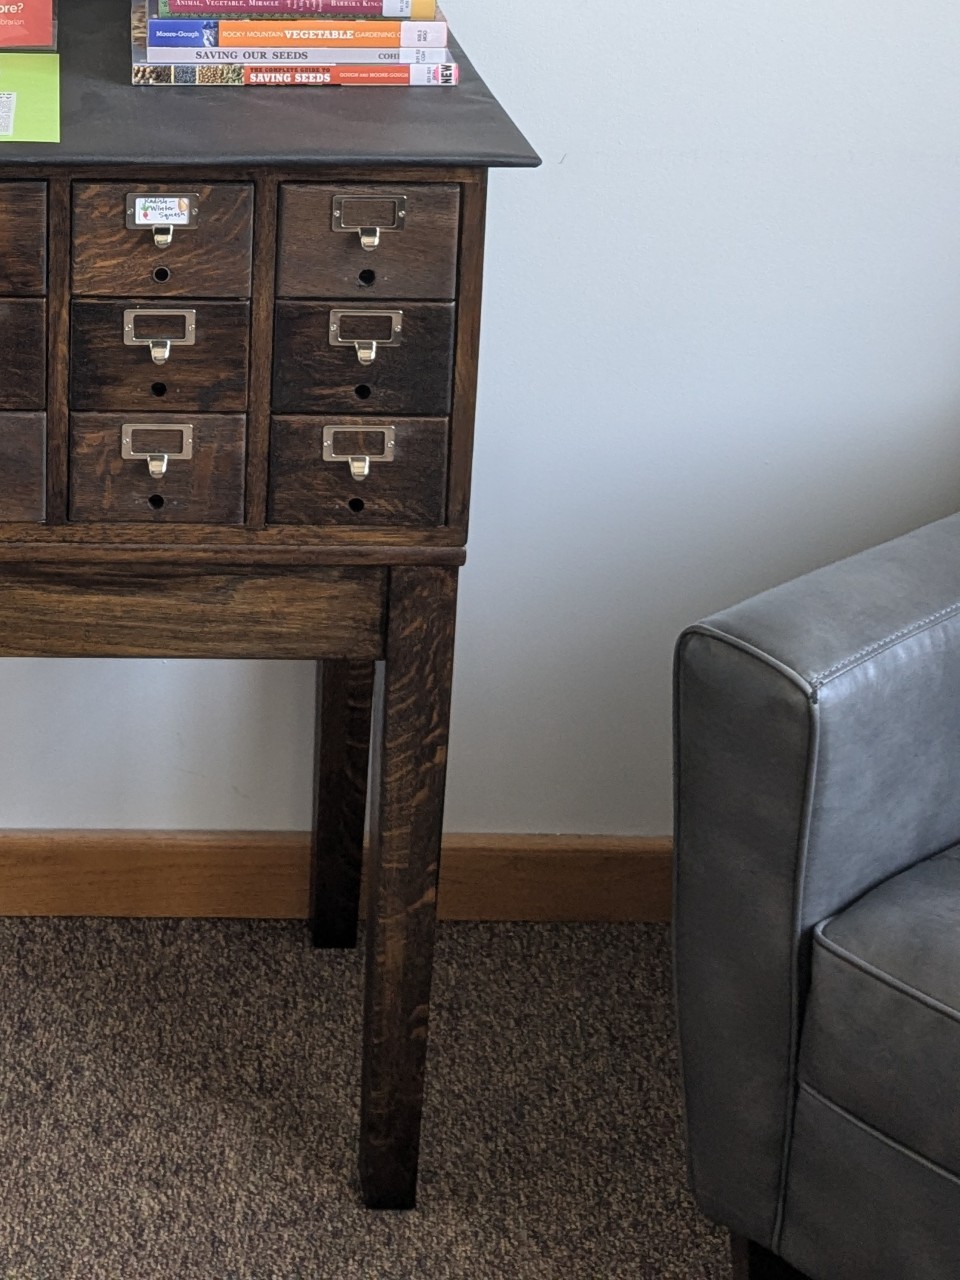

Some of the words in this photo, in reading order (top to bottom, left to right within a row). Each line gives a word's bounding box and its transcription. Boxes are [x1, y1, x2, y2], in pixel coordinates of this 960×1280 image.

[175, 0, 204, 7] ANIMAL,
[205, 0, 247, 7] VEGETABLE,
[330, 0, 361, 7] BARBARA
[155, 30, 200, 38] Moore-Gough
[284, 30, 355, 39] VEGETABLE
[195, 51, 238, 60] SAVING
[242, 51, 268, 60] OUR
[271, 51, 309, 60] SEEDS
[249, 73, 291, 82] SAVING
[294, 73, 331, 82] SEEDS
[440, 64, 453, 84] NEW
[150, 204, 175, 212] Winter
[158, 211, 186, 220] Squash
